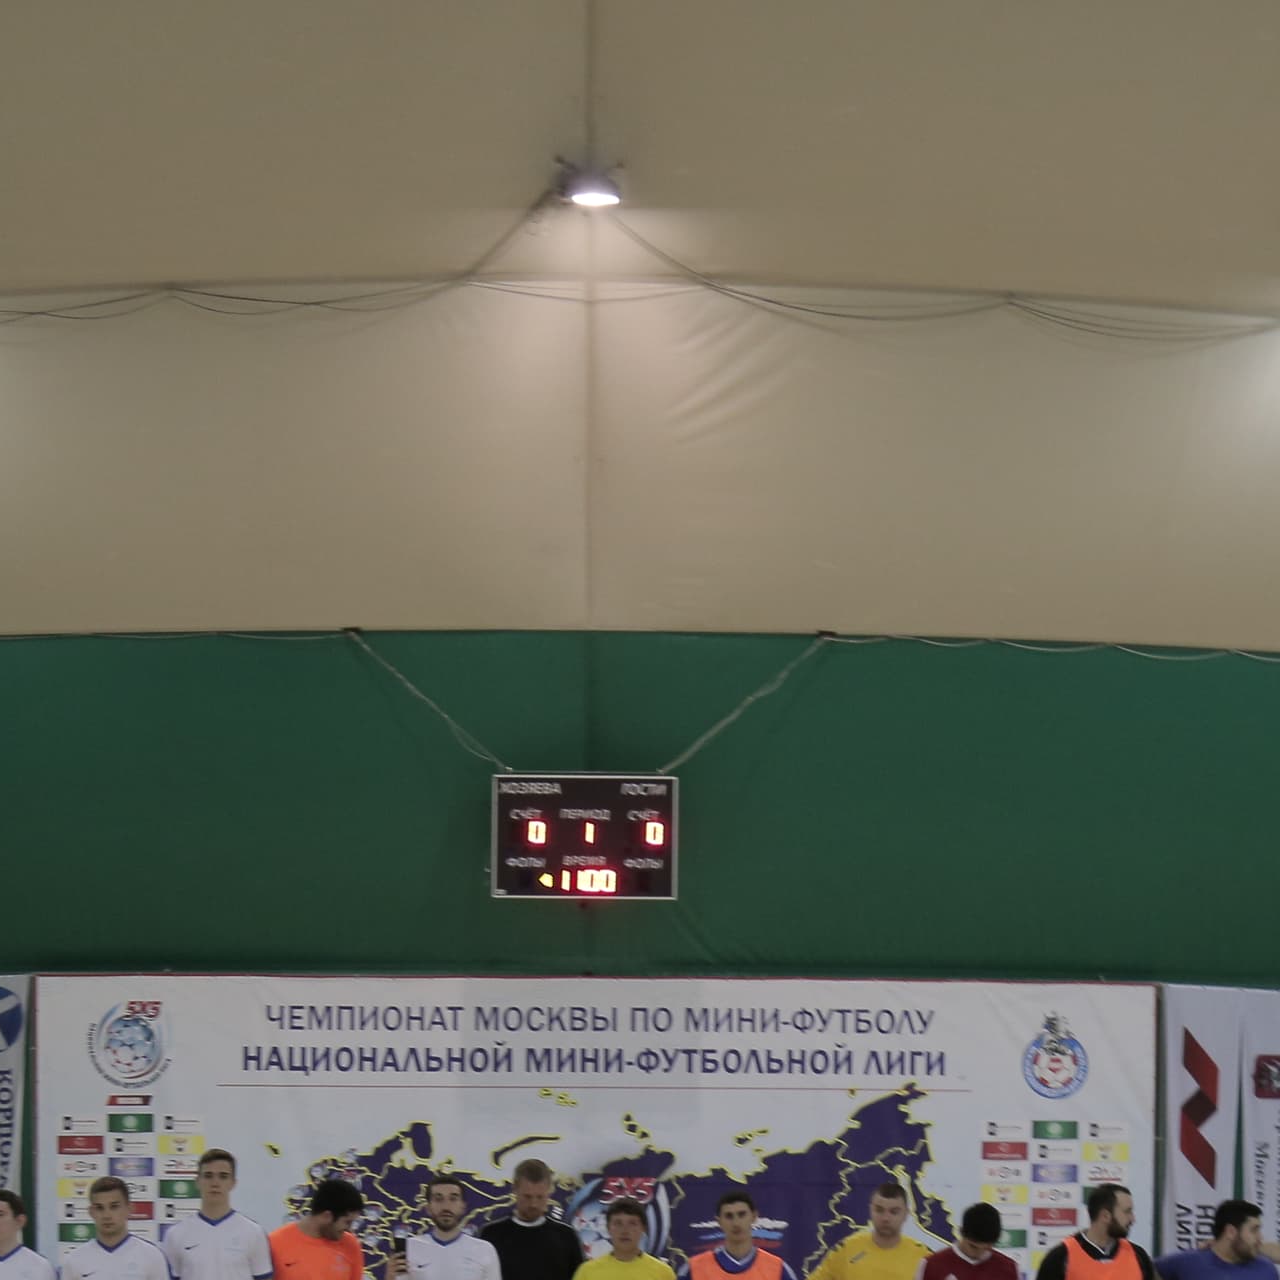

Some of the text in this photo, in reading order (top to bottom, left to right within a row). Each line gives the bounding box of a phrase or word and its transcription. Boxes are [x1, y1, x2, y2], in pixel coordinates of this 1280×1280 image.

[527, 820, 546, 845] 0
[585, 821, 595, 845] 1
[645, 821, 664, 845] 0
[265, 1004, 935, 1035] ЧЕМПИОНАТ МОСКВЫ ПО МИНИ-ФУТБОЛУ
[242, 1041, 946, 1077] НАЦИОНАЛЬНОЙ МИНИ-ФУТБОЛЬНОЙ ЛИГИ
